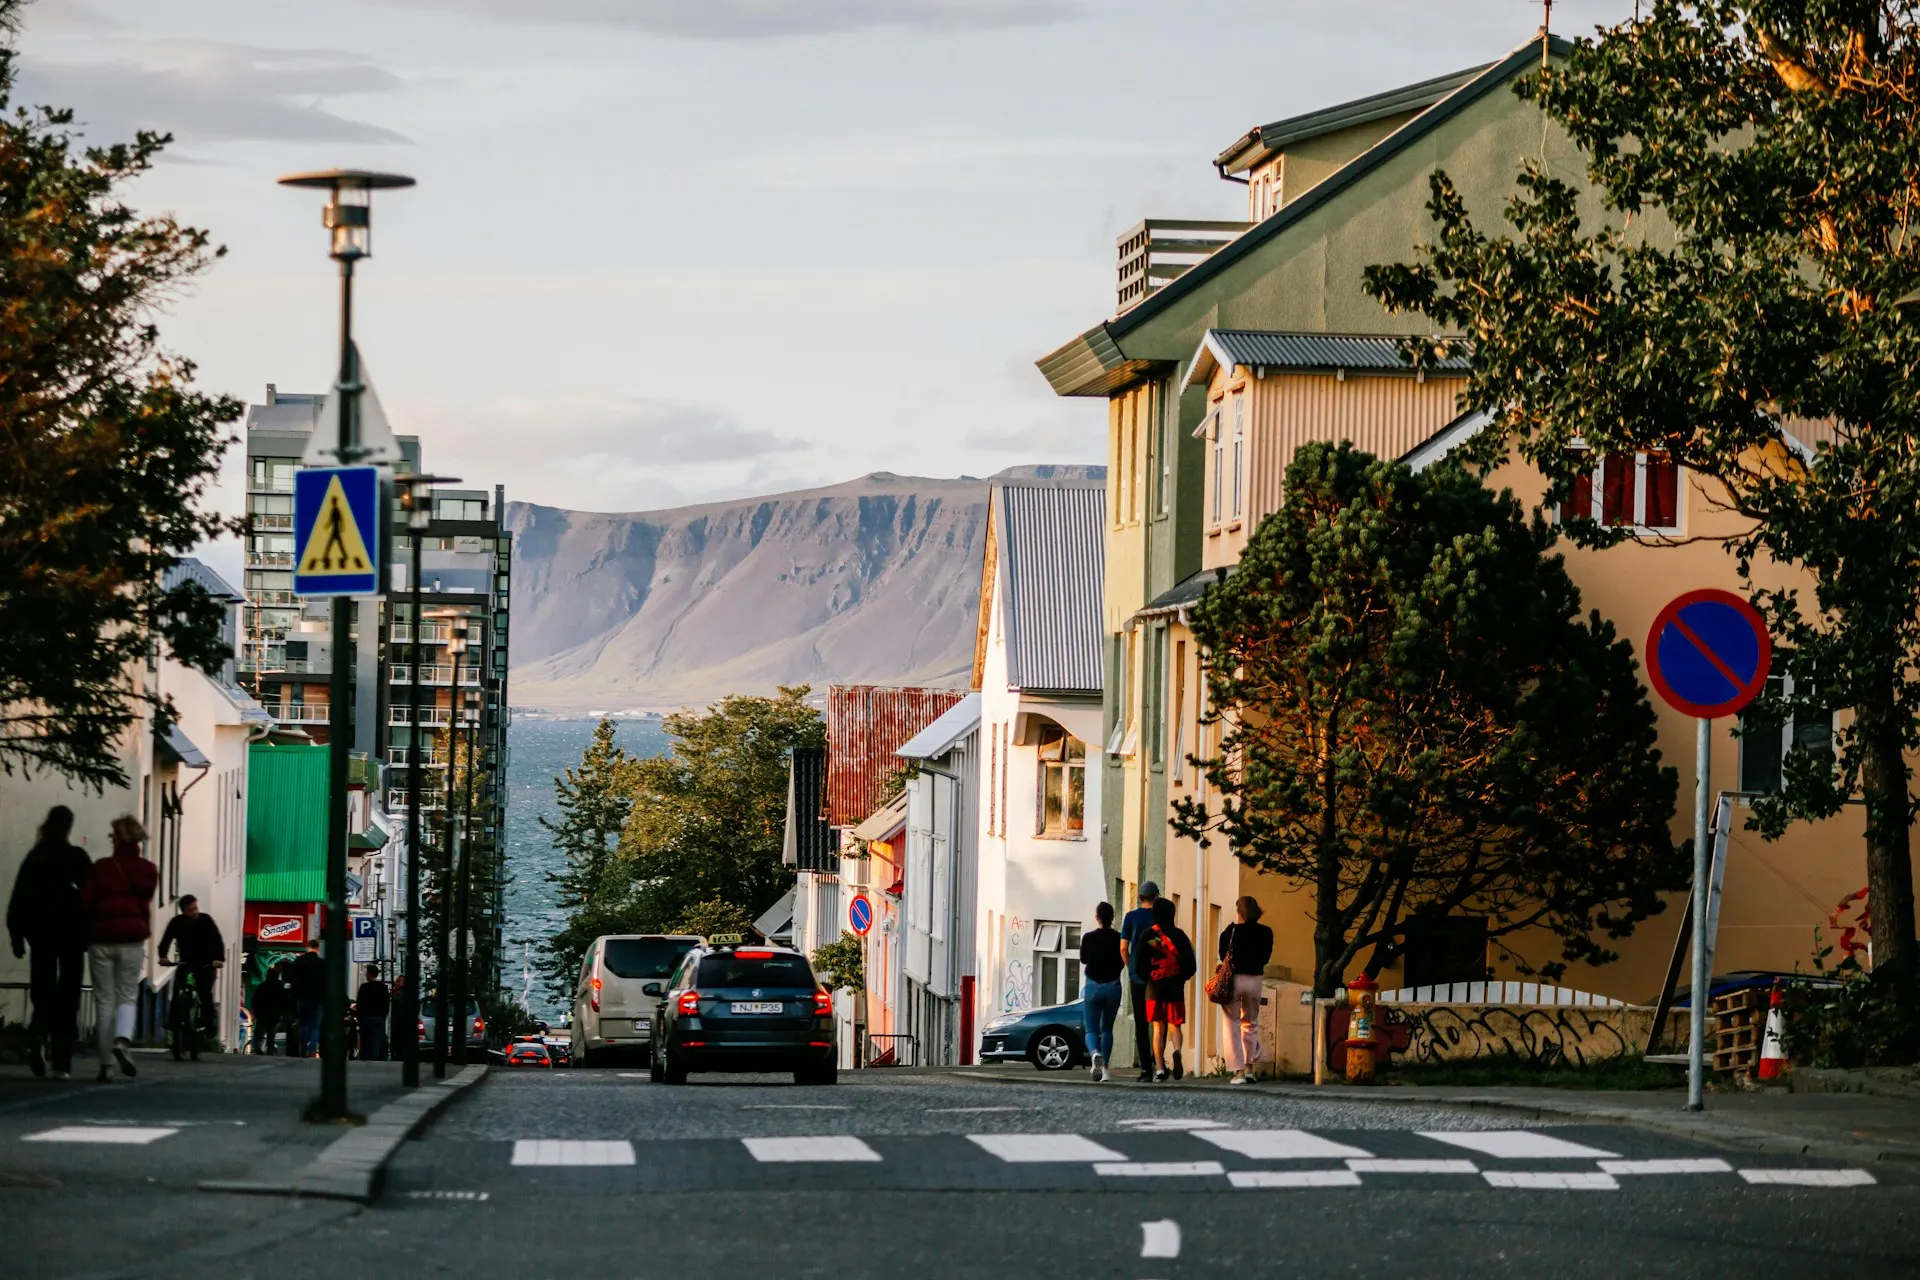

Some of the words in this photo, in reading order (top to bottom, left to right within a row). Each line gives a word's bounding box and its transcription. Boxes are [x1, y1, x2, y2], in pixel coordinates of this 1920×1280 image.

[262, 920, 299, 936] Snapple
[360, 920, 372, 935] P
[712, 934, 738, 943] TAXI
[739, 1003, 753, 1012] NJ
[760, 1003, 781, 1012] P35
